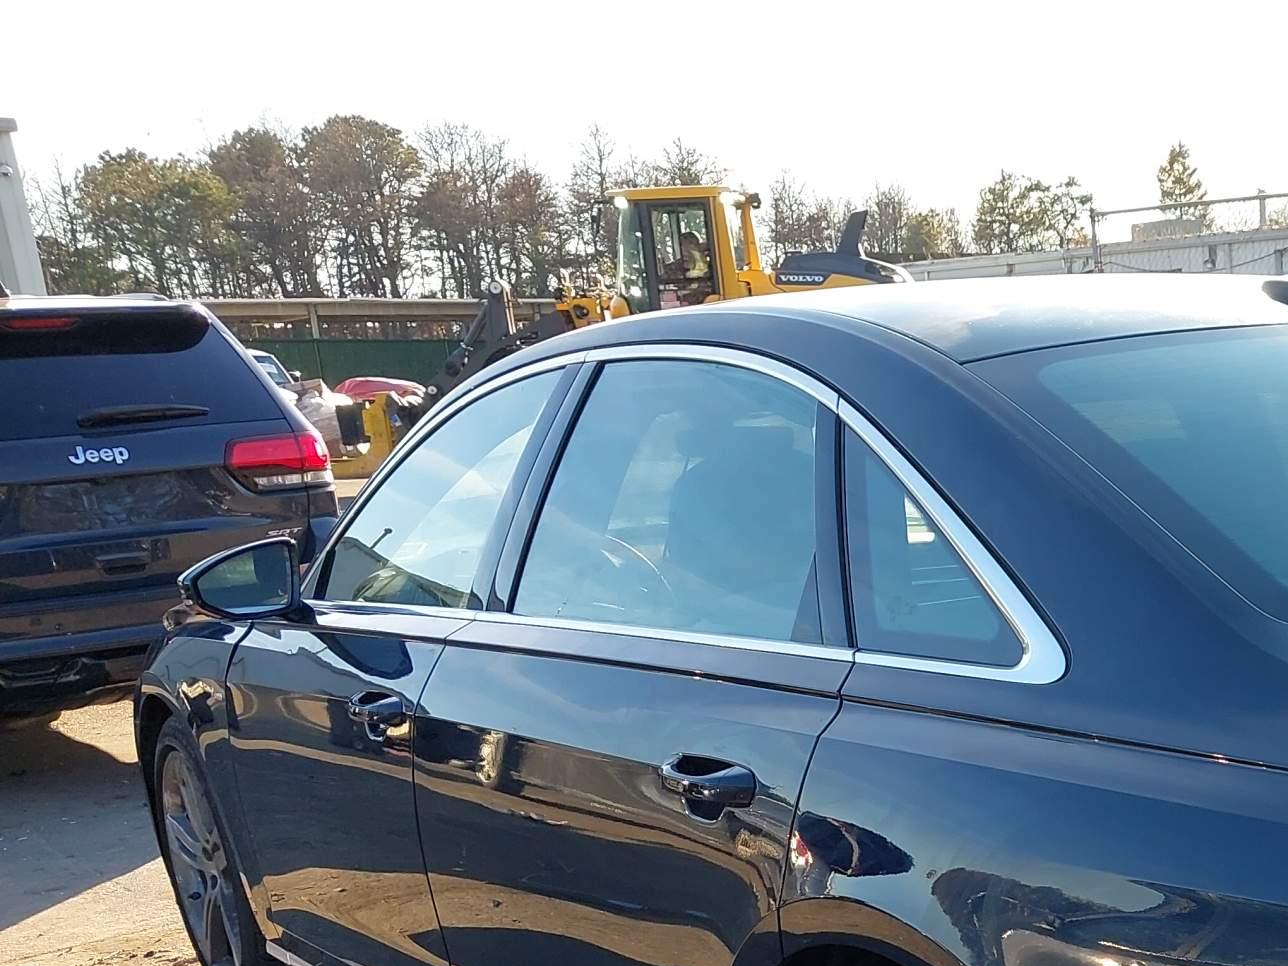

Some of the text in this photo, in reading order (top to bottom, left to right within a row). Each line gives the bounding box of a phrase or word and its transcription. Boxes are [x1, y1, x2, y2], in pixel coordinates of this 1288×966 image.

[779, 274, 825, 282] VOLVO
[67, 445, 129, 465] Jeep
[265, 527, 303, 538] SRT
